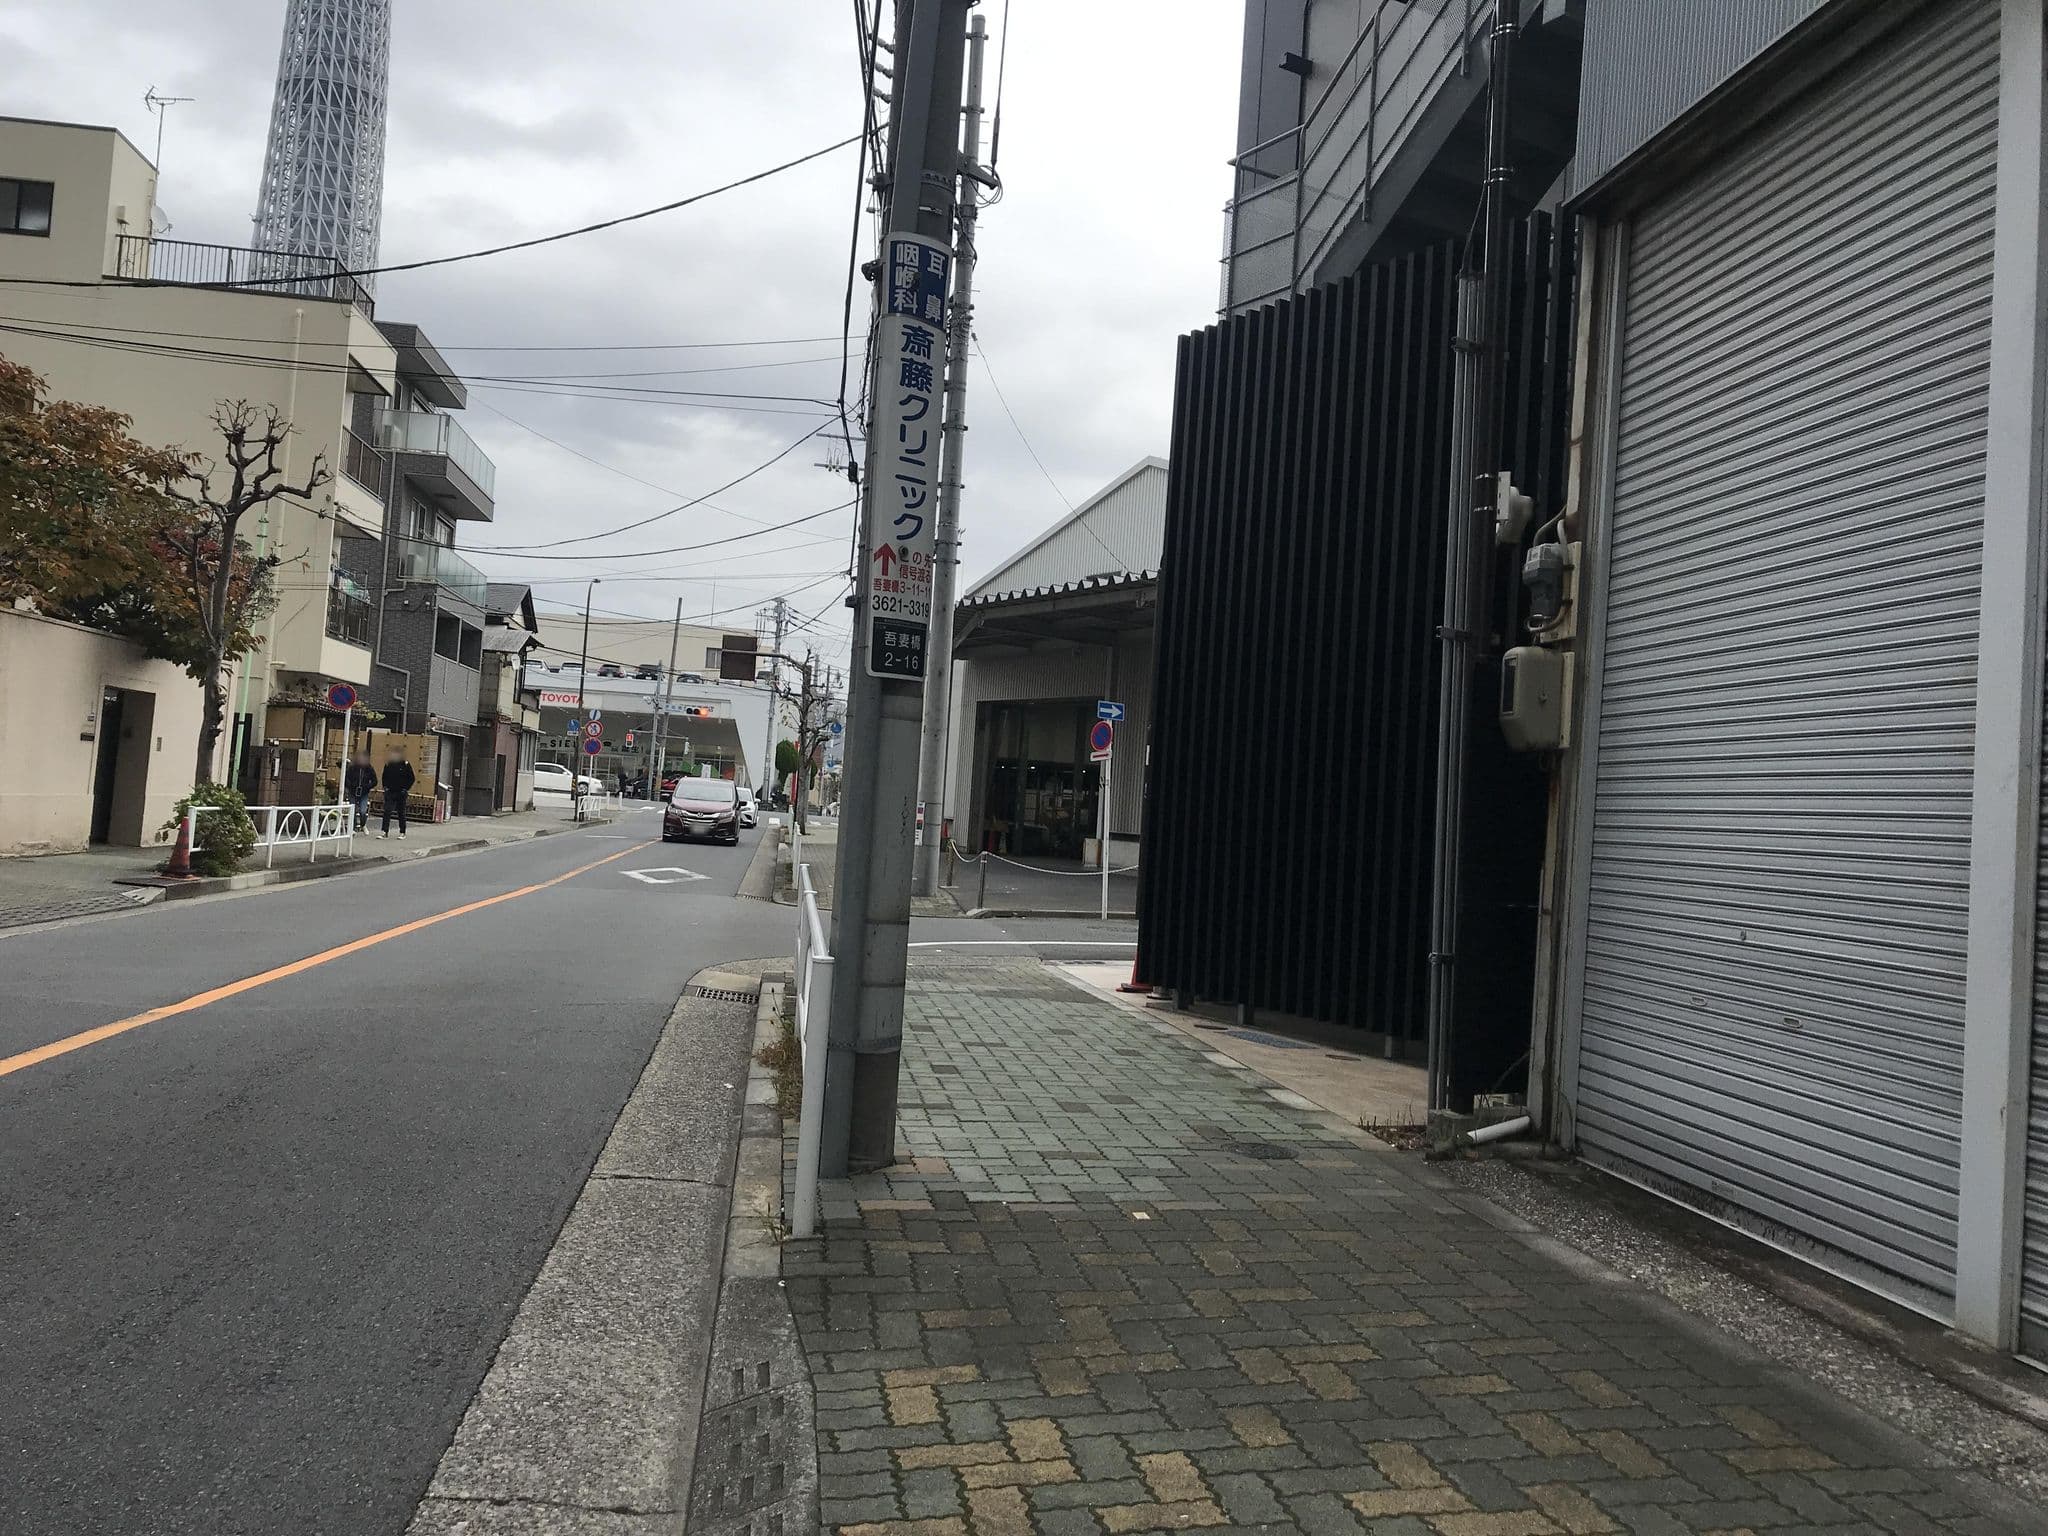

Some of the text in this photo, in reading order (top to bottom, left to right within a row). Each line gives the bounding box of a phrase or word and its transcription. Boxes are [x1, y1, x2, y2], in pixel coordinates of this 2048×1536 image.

[894, 243, 919, 314] 咽喉科
[925, 250, 945, 322] 耳鼻
[894, 324, 935, 541] 斎藤クリニック
[872, 594, 930, 618] 3621-3319
[884, 630, 921, 650] 吾妻橋
[884, 652, 919, 670] 2-16
